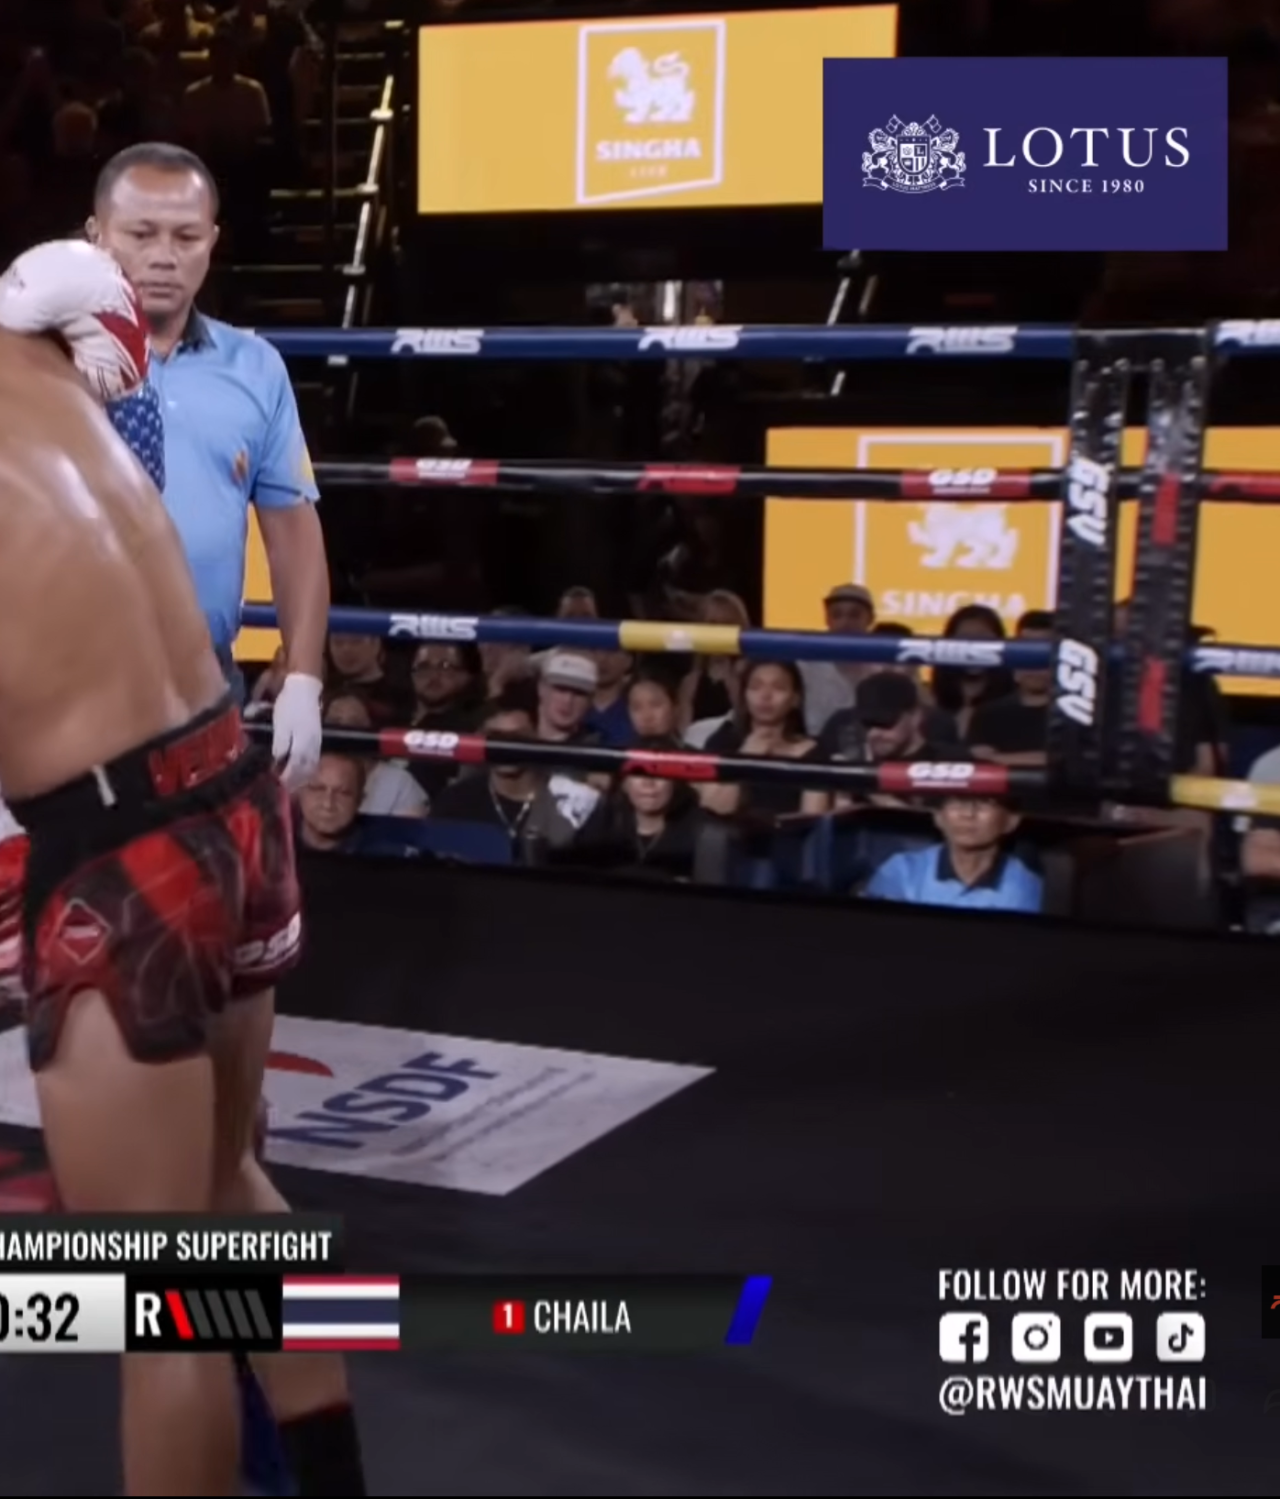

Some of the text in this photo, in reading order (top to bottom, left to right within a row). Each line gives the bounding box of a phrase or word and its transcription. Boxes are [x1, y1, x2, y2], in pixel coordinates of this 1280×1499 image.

[595, 137, 703, 161] SINGHA
[390, 328, 485, 355] RWS
[906, 326, 1018, 355] RWS
[928, 467, 998, 486] GSD
[388, 612, 479, 641] RWS
[897, 638, 1006, 666] RWS
[403, 730, 460, 748] GSD
[907, 761, 977, 780] GSD
[265, 1052, 500, 1150] NSDF
